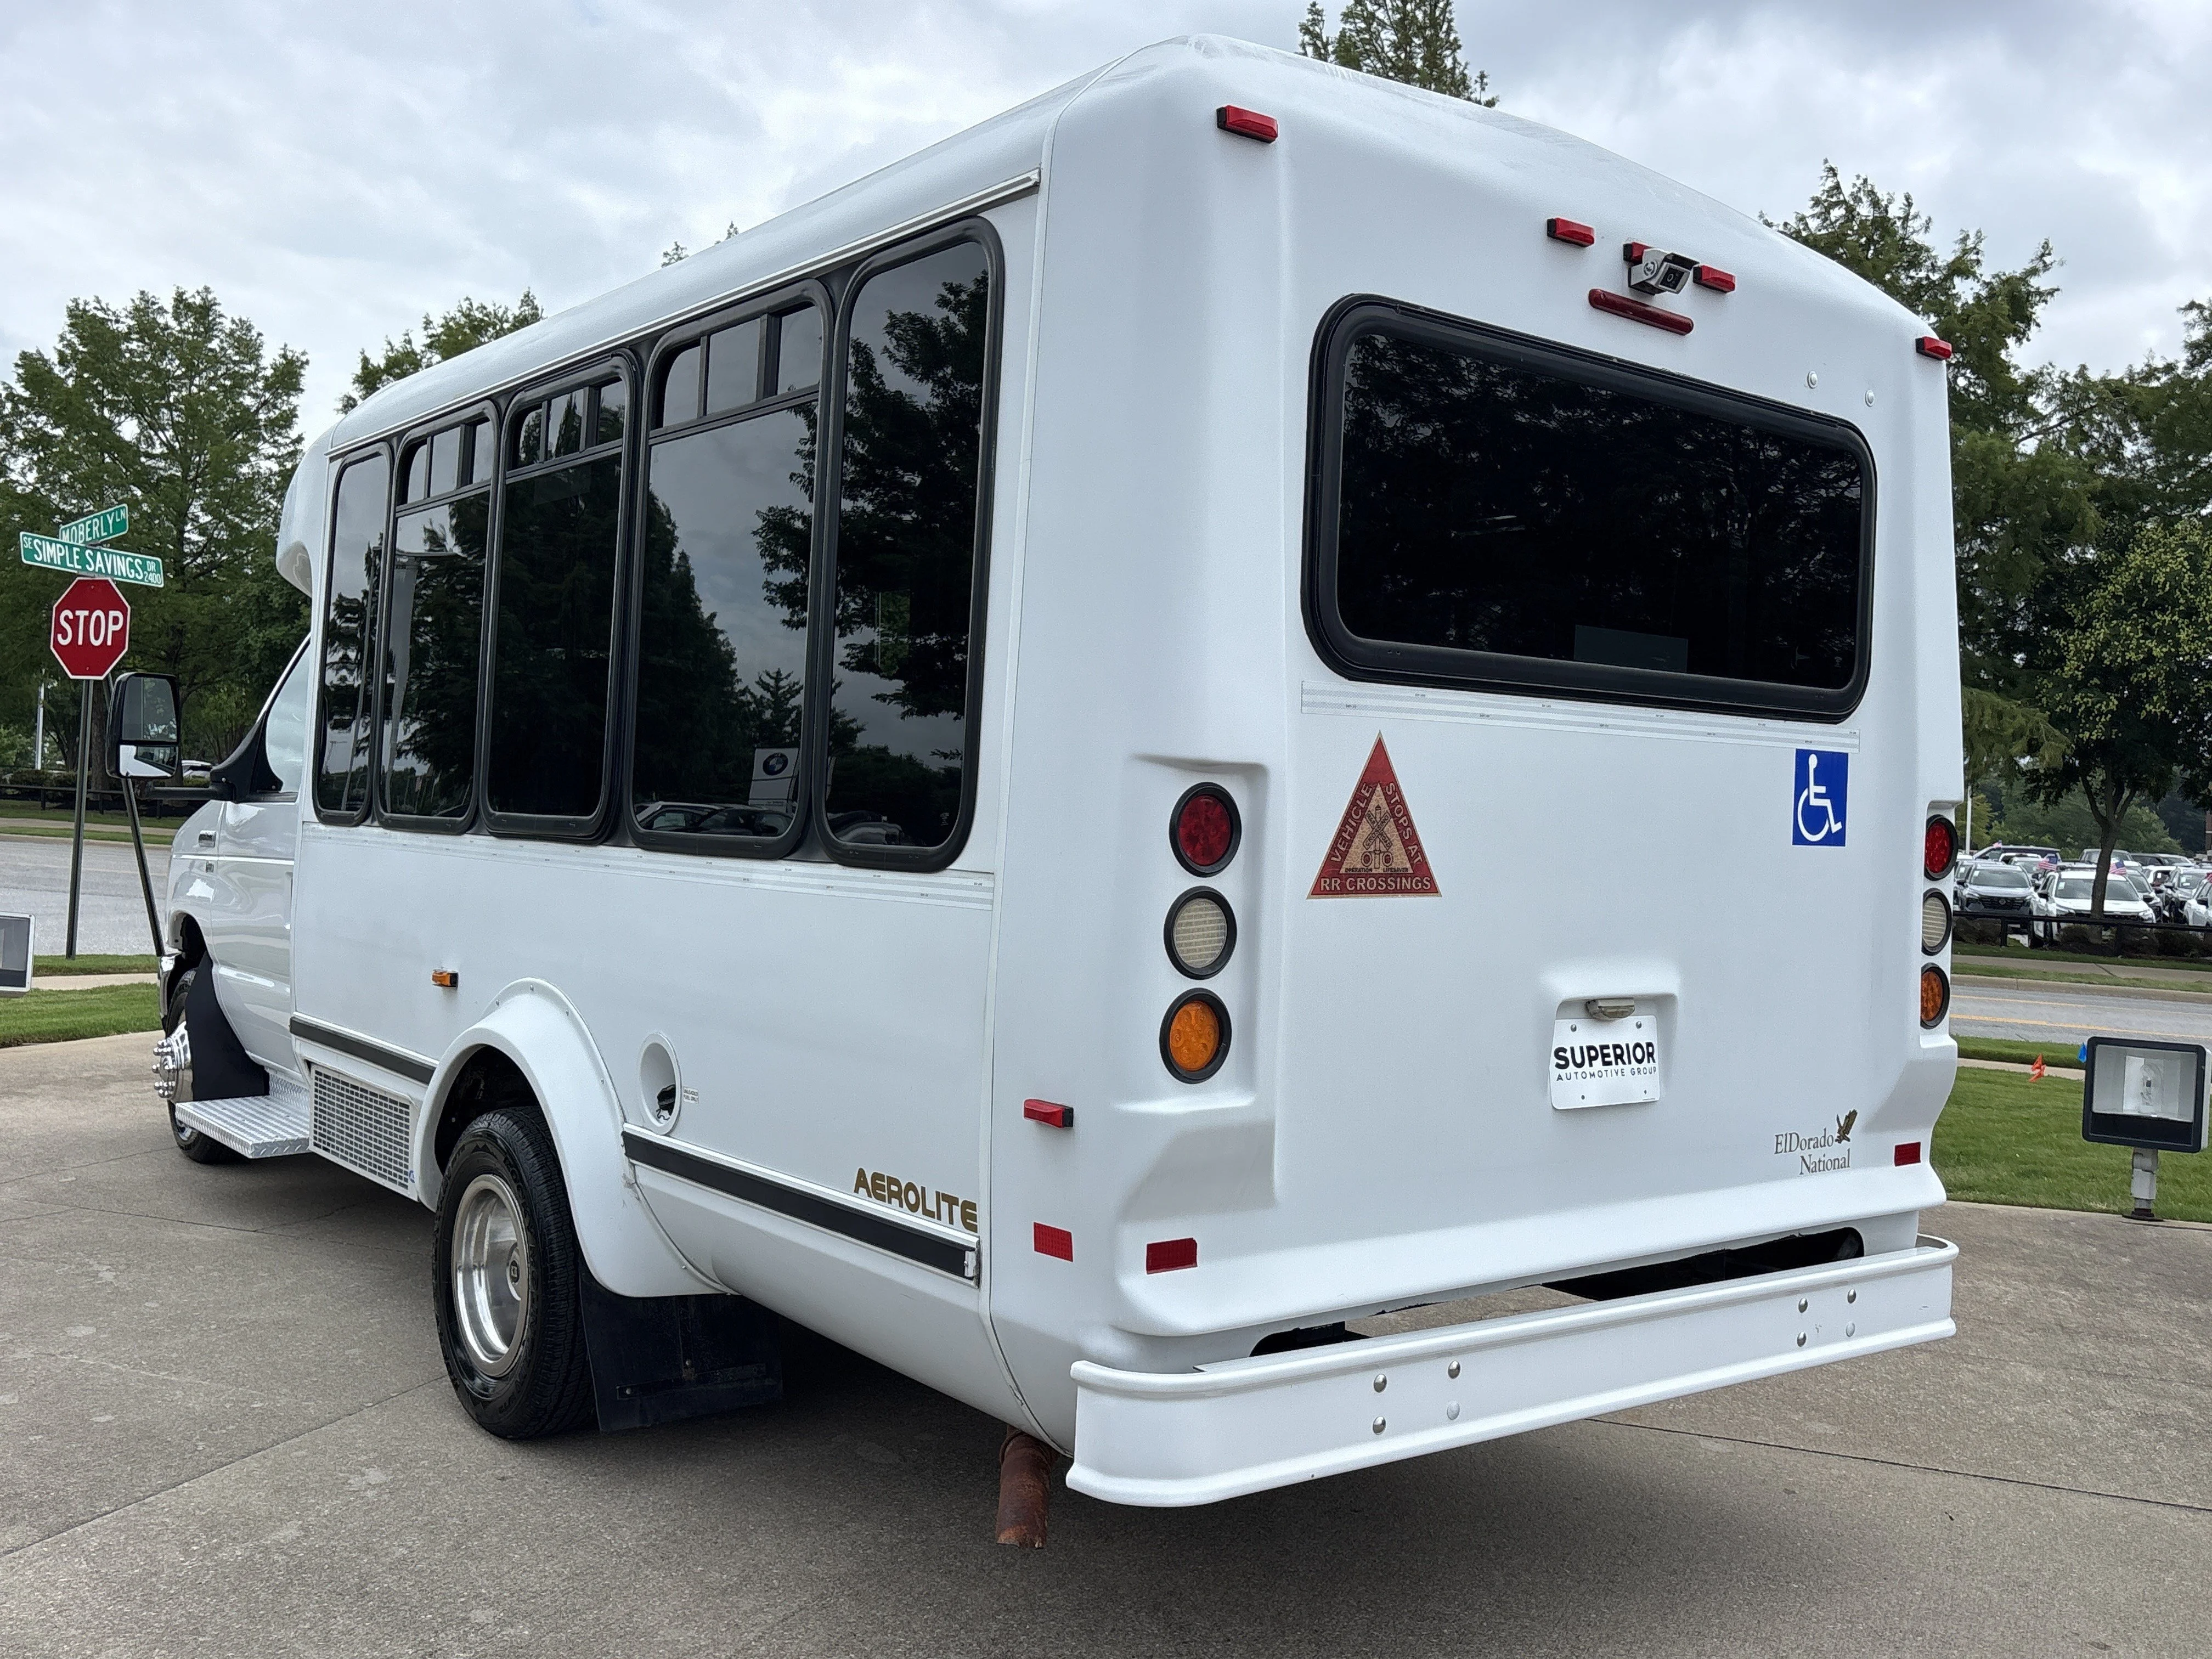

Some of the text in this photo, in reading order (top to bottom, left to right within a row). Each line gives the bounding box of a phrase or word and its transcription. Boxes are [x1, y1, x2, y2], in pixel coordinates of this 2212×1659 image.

[62, 509, 126, 544] MOBERLY LN
[23, 536, 156, 580] SE SIMPLE SAVINGS DR
[144, 572, 161, 584] 2400
[57, 610, 123, 646] STOP
[1330, 782, 1372, 862] VEHICLE
[1386, 782, 1423, 865] STOPS AT
[1321, 877, 1431, 891] RR CROSSINGS
[1554, 1042, 1656, 1069] SUPERIOR
[1556, 1066, 1656, 1081] AUTOMOTIVE GROUP
[1774, 1127, 1834, 1154] ElDorado
[1799, 1148, 1850, 1175] National
[854, 1167, 978, 1233] AEROLITE
